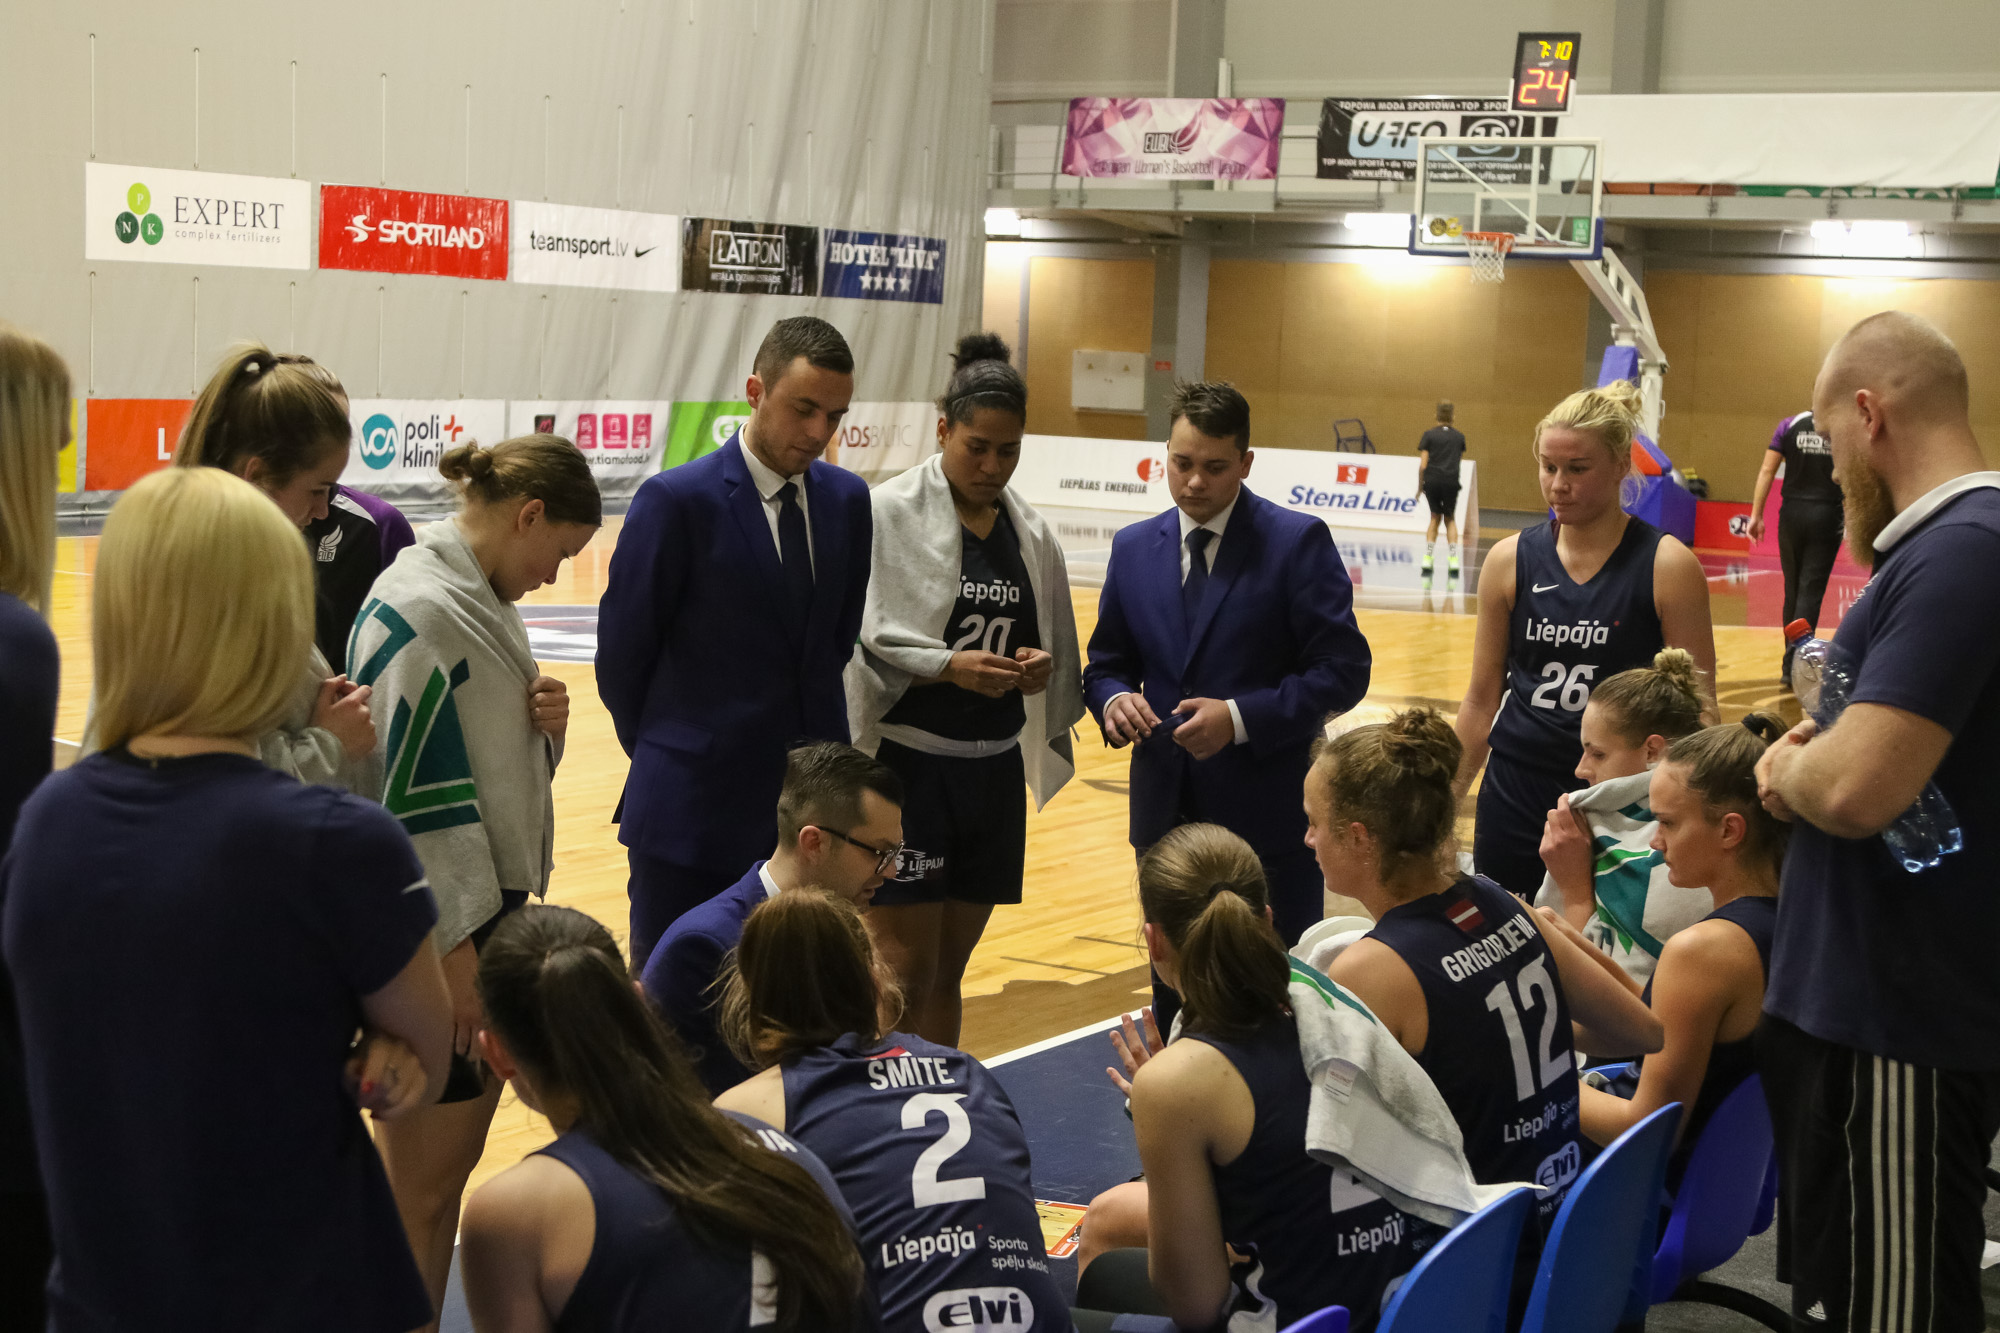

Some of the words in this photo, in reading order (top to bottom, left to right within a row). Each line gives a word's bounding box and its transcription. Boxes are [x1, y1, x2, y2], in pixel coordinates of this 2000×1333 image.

[1539, 41, 1573, 60] 7:10
[1518, 69, 1569, 104] 24
[1340, 101, 1376, 111] TOPOWA
[1378, 102, 1405, 111] MODA
[1407, 101, 1456, 111] SPORTOWA
[1462, 101, 1480, 110] TOP
[1483, 101, 1508, 111] SPOR
[137, 193, 144, 205] P
[174, 196, 284, 230] EXPERT
[122, 221, 132, 234] N
[147, 223, 156, 235] K
[175, 229, 221, 241] complex
[226, 231, 281, 243] fertilizers
[378, 219, 485, 249] SPORTLAND
[530, 230, 629, 259] teamsport.lv
[829, 242, 889, 267] HOTEL
[404, 415, 439, 440] poli
[1288, 485, 1359, 509] Stena
[1363, 490, 1417, 513] Line
[957, 575, 1020, 607] iepāja
[1526, 617, 1609, 649] Liepāja
[1530, 661, 1599, 712] 26
[1441, 913, 1537, 983] GRIGORJEVA
[1485, 952, 1572, 1102] 12
[901, 1092, 986, 1209] 2
[881, 1225, 976, 1269] Liepāja
[988, 1235, 1029, 1252] Sporta
[991, 1254, 1026, 1271] spēļu
